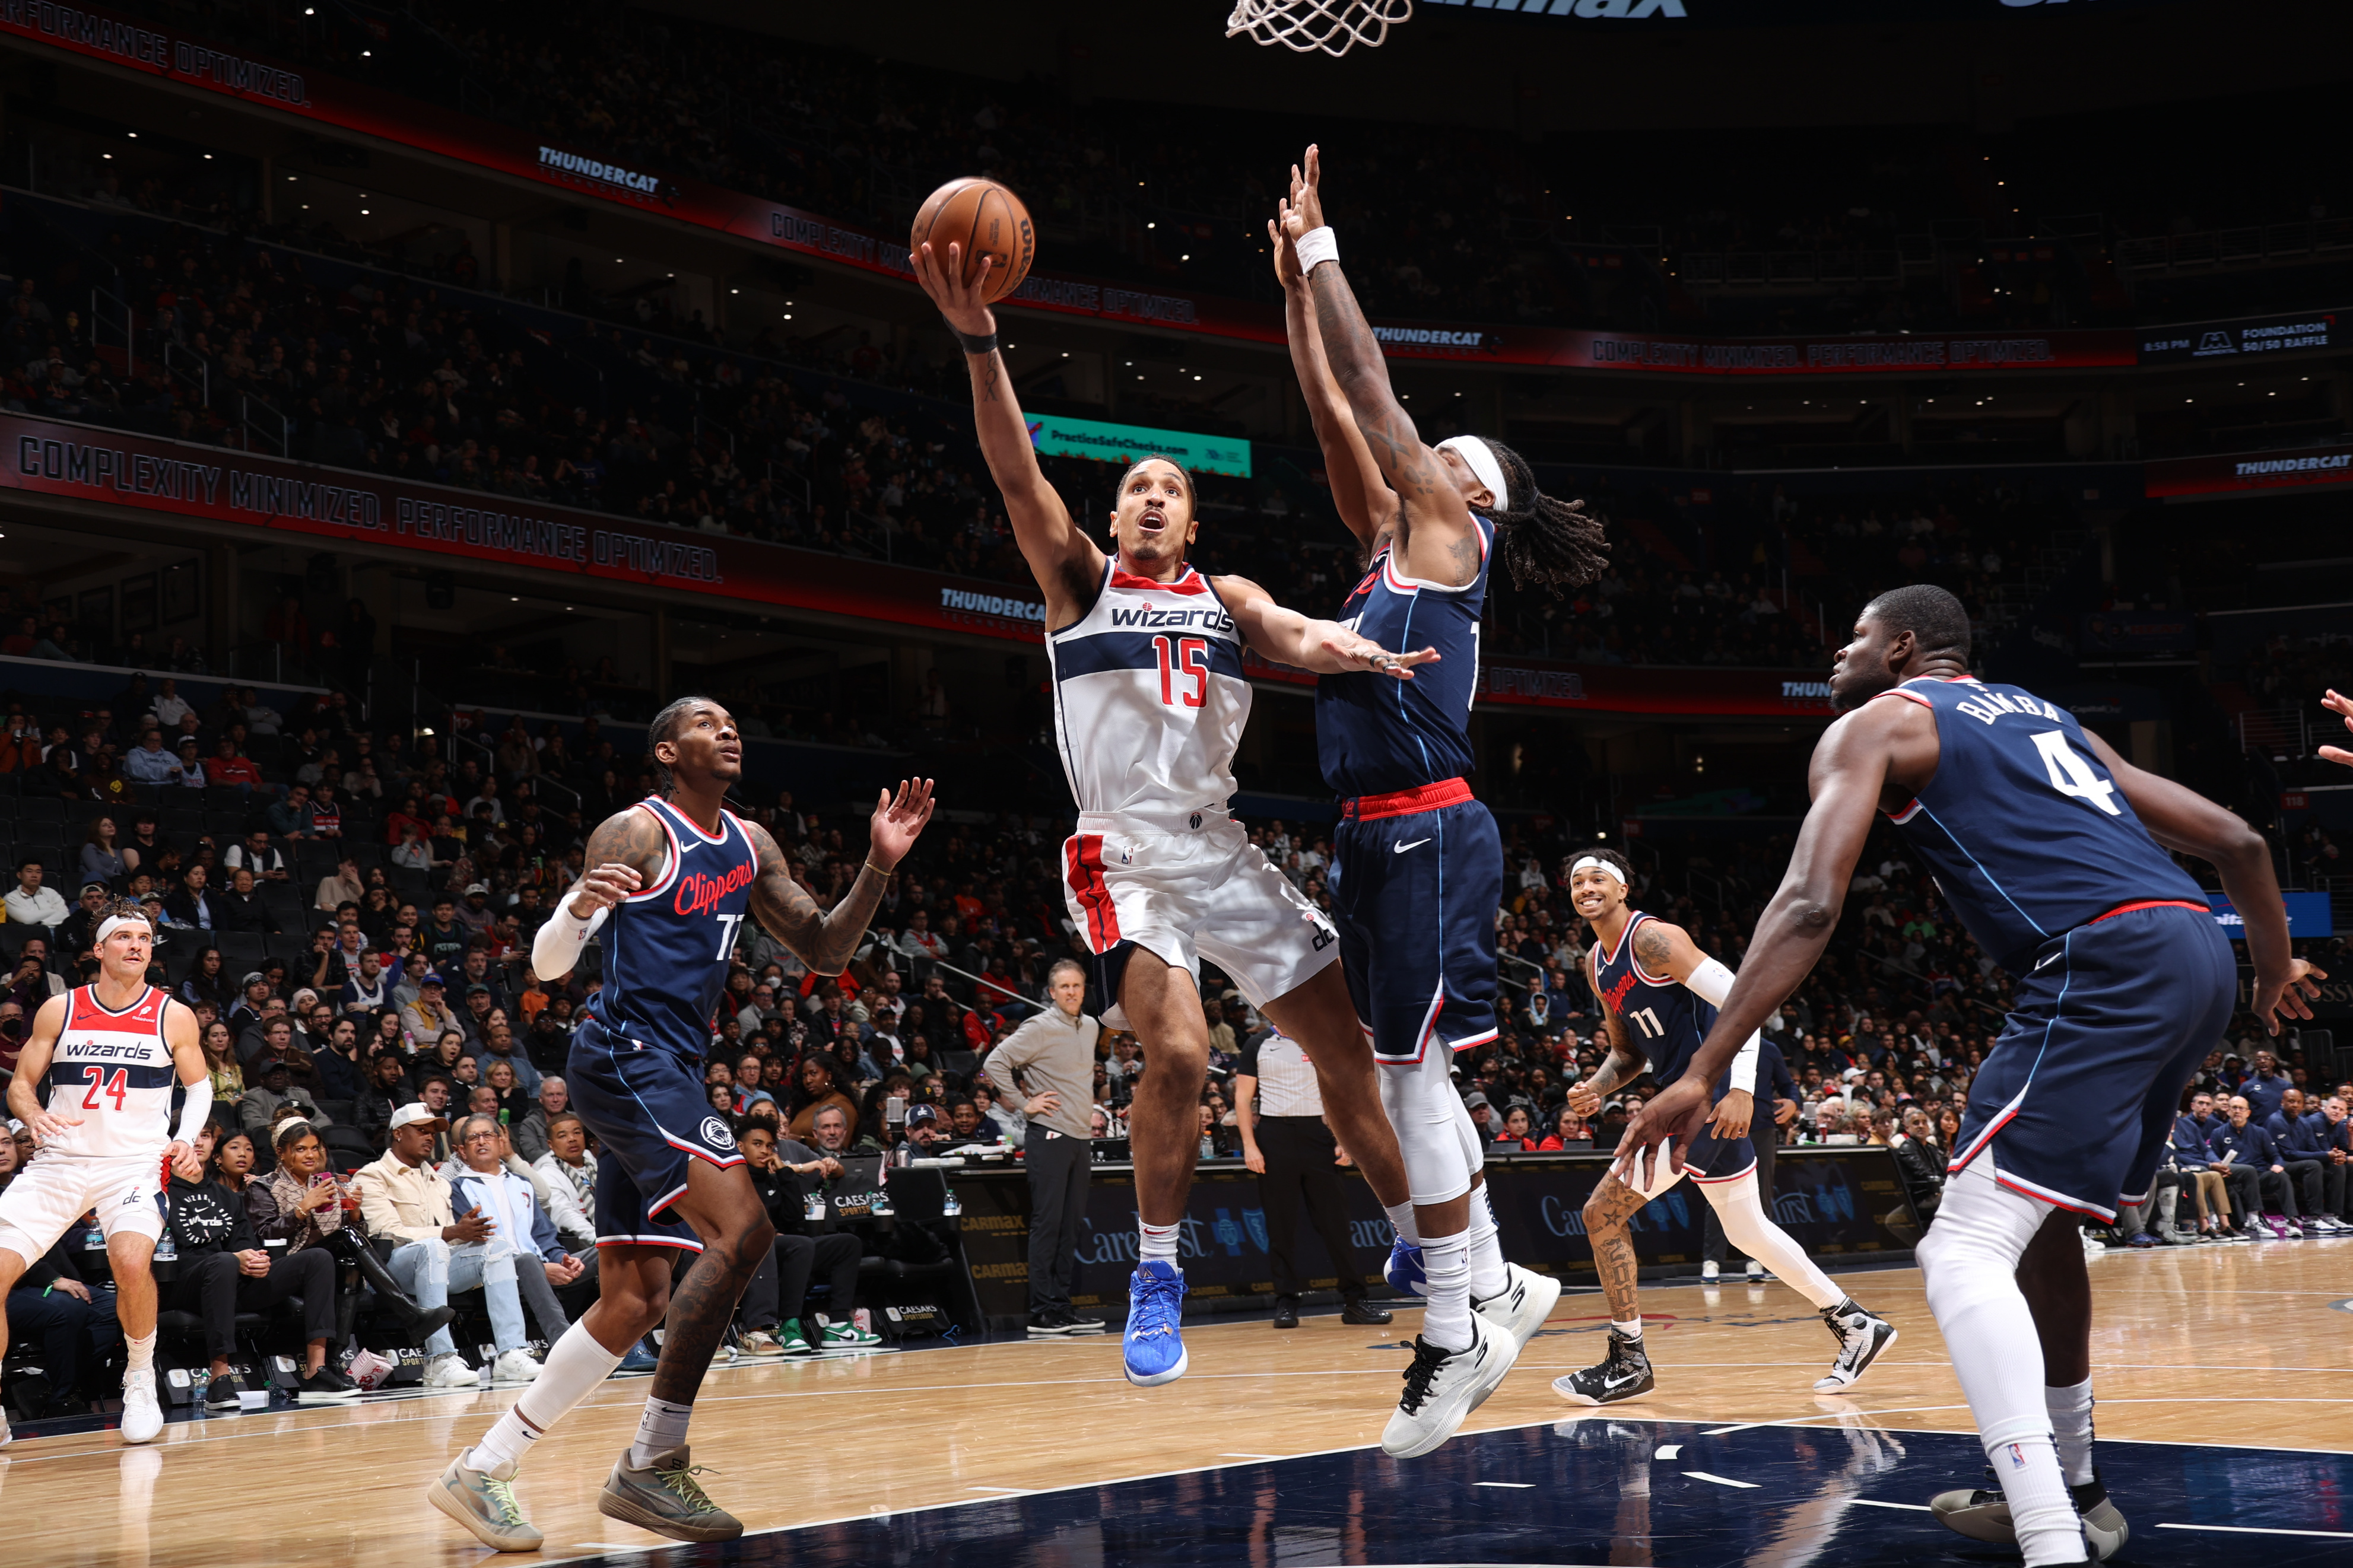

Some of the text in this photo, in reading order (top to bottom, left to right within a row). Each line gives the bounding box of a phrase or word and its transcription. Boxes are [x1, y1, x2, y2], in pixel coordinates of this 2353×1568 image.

[0, 0, 312, 109] RFORMANCE OPTIMIZED.
[538, 145, 659, 193] THUNDERCAT
[771, 211, 875, 264] COMPLEXITY
[1103, 287, 1201, 325] OPTIMIZED.
[1371, 327, 1483, 346] THUNDERCAT
[2170, 339, 2191, 349] PM
[2241, 339, 2281, 352] 50/50
[2284, 335, 2329, 348] RAFFLE
[2241, 322, 2327, 339] FOUNDATION
[1593, 338, 2055, 368] COMPLEXITY MINIMIZED. PERFORMANCE OPTIMIZED.
[2235, 454, 2353, 475] THUNDERCAT
[18, 435, 724, 585] COMPLEXITY MINIMIZED. PERFORMANCE OPTIMIZED.
[940, 588, 1046, 622] THUNDERCA
[1112, 601, 1234, 632] wizards
[942, 612, 1043, 637] TECHNOLOG
[1152, 635, 1208, 709] 15
[1490, 666, 1587, 701] OPTIMIZED.
[1956, 693, 2062, 726] BAMBA
[2029, 730, 2122, 816] 4
[2284, 796, 2305, 807] 118
[674, 860, 753, 916] Clippers
[132, 1015, 155, 1023] Robinhood
[1629, 1007, 1665, 1039] 11
[66, 1040, 154, 1060] wizards
[82, 1066, 128, 1112] 24
[839, 1206, 871, 1217] SPORTSB
[970, 1261, 1029, 1280] CARma
[900, 1305, 938, 1315] CAESARS
[903, 1312, 935, 1321] SPORTSBOOK
[399, 1348, 427, 1359] CAES
